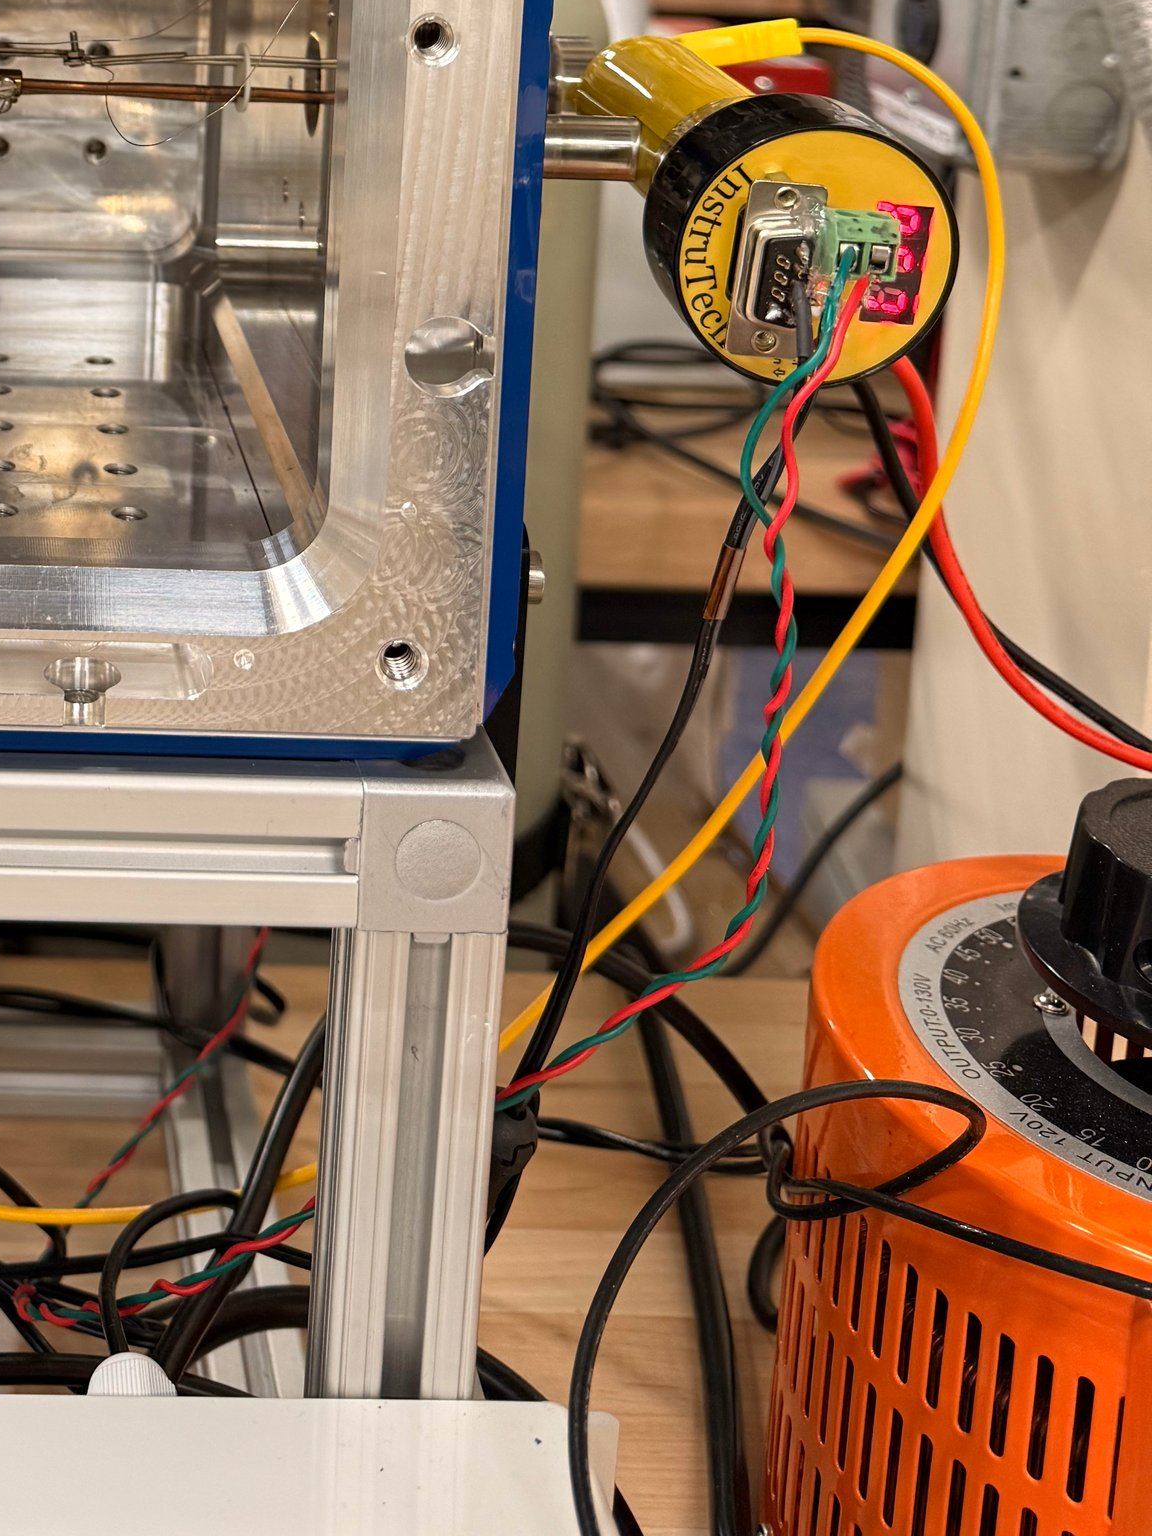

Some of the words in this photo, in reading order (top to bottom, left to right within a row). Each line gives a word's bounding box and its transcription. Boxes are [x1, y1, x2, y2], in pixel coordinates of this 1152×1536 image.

[954, 945, 981, 962] 45
[942, 968, 969, 984] 40
[942, 995, 970, 1013] 35
[955, 1027, 985, 1044] 30
[980, 1060, 1016, 1078] 25
[1019, 1093, 1055, 1112] 20
[1009, 1112, 1067, 1146] 120V
[1074, 1128, 1106, 1148] 15
[1076, 1152, 1152, 1192] NPUT
